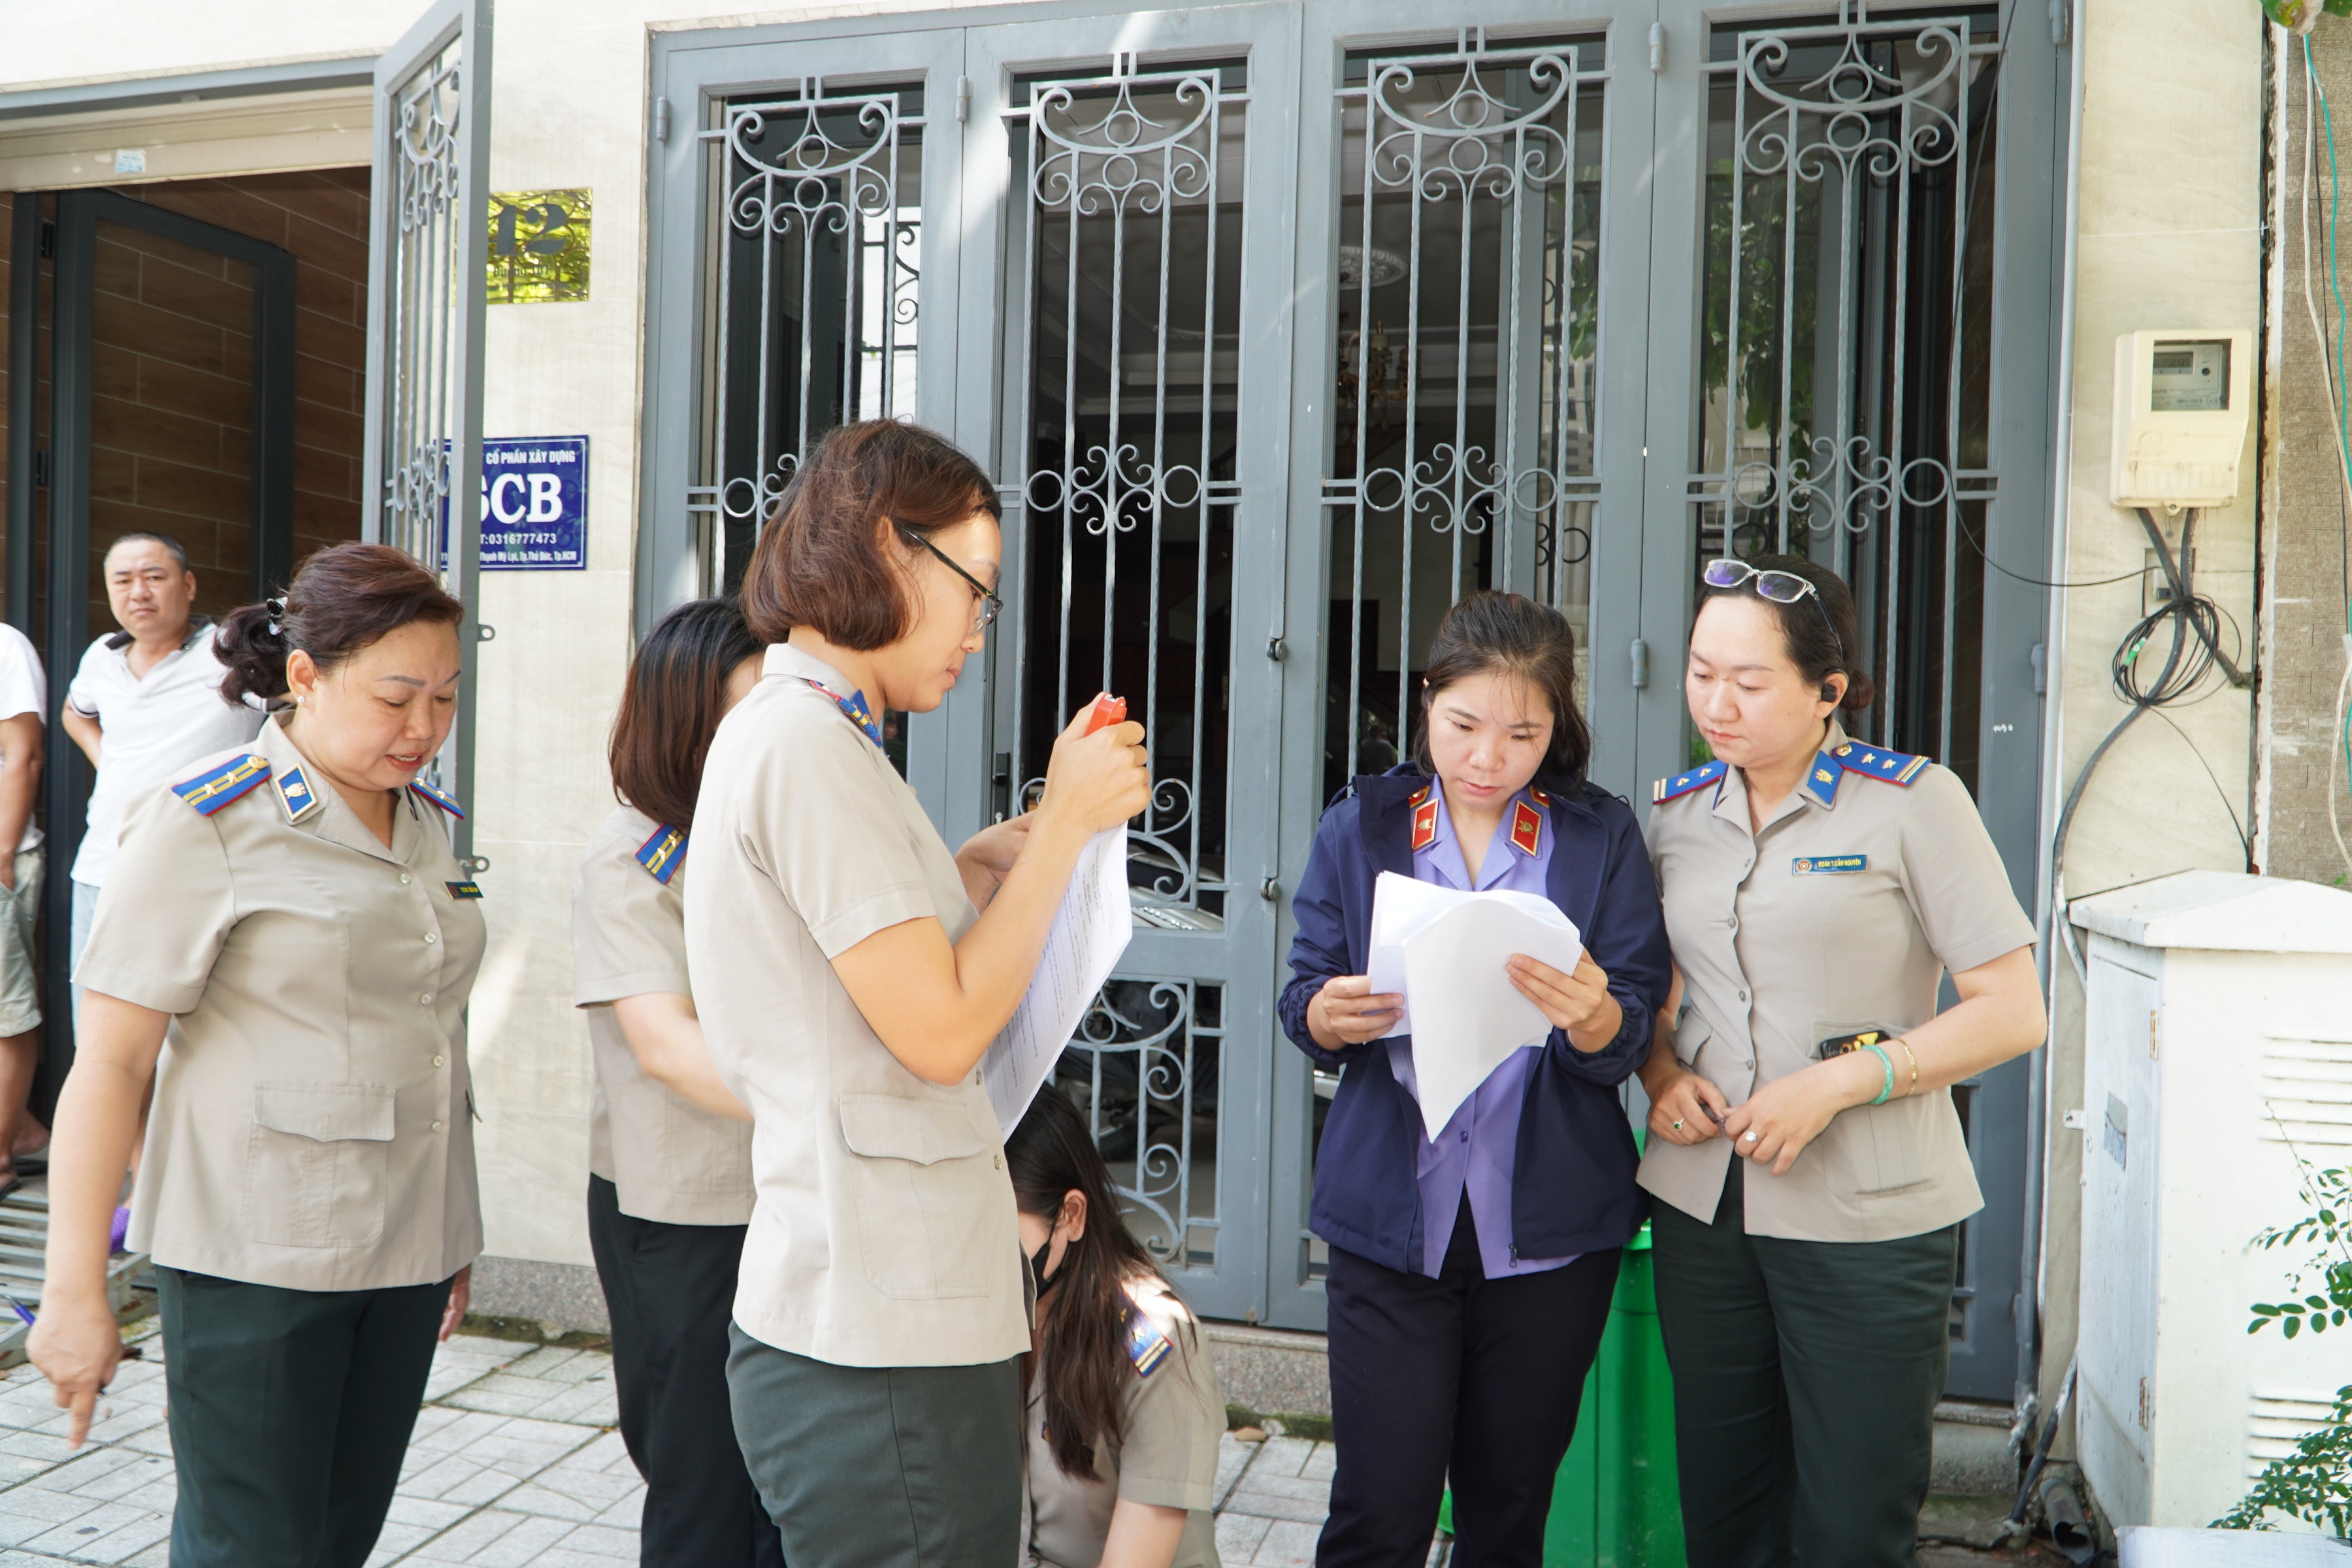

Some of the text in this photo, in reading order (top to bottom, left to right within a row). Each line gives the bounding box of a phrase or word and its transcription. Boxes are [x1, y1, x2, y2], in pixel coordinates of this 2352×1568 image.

[497, 203, 568, 255] 12
[486, 448, 576, 465] CỔ PHẦN XÂY DỰNG
